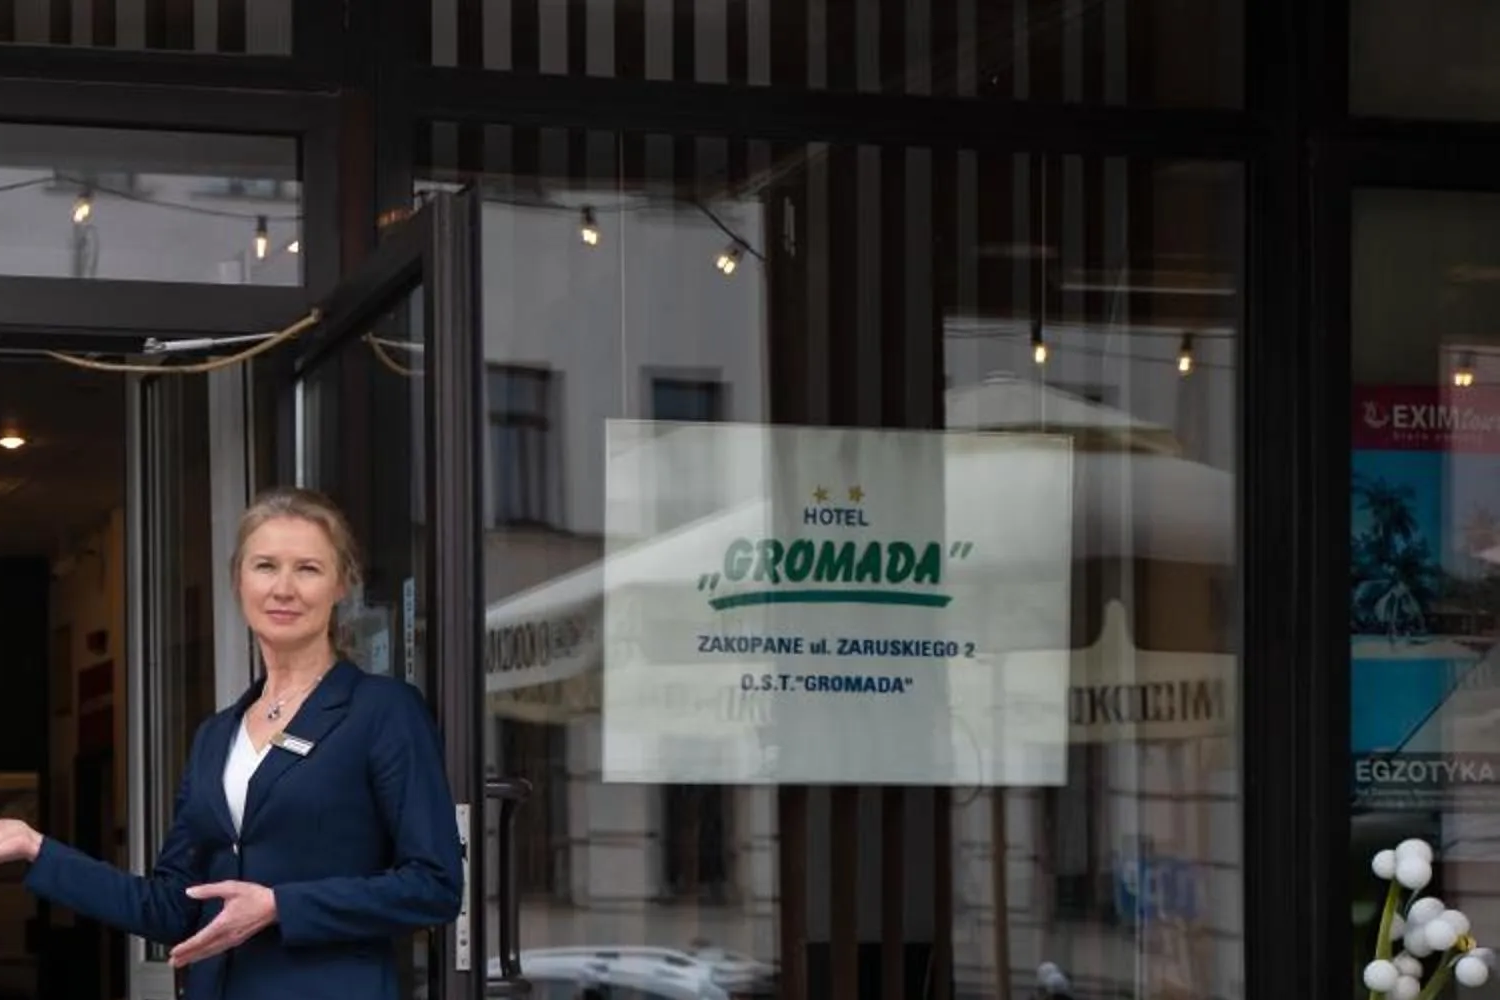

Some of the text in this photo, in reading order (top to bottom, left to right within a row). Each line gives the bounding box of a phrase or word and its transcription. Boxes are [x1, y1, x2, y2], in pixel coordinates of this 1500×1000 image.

[1393, 404, 1459, 429] EXIM
[803, 507, 869, 527] HOTEL
[697, 635, 976, 658] ZAKOPANE ul. ZARUSKIEGO 2
[1356, 760, 1494, 782] EGZOTYKA
